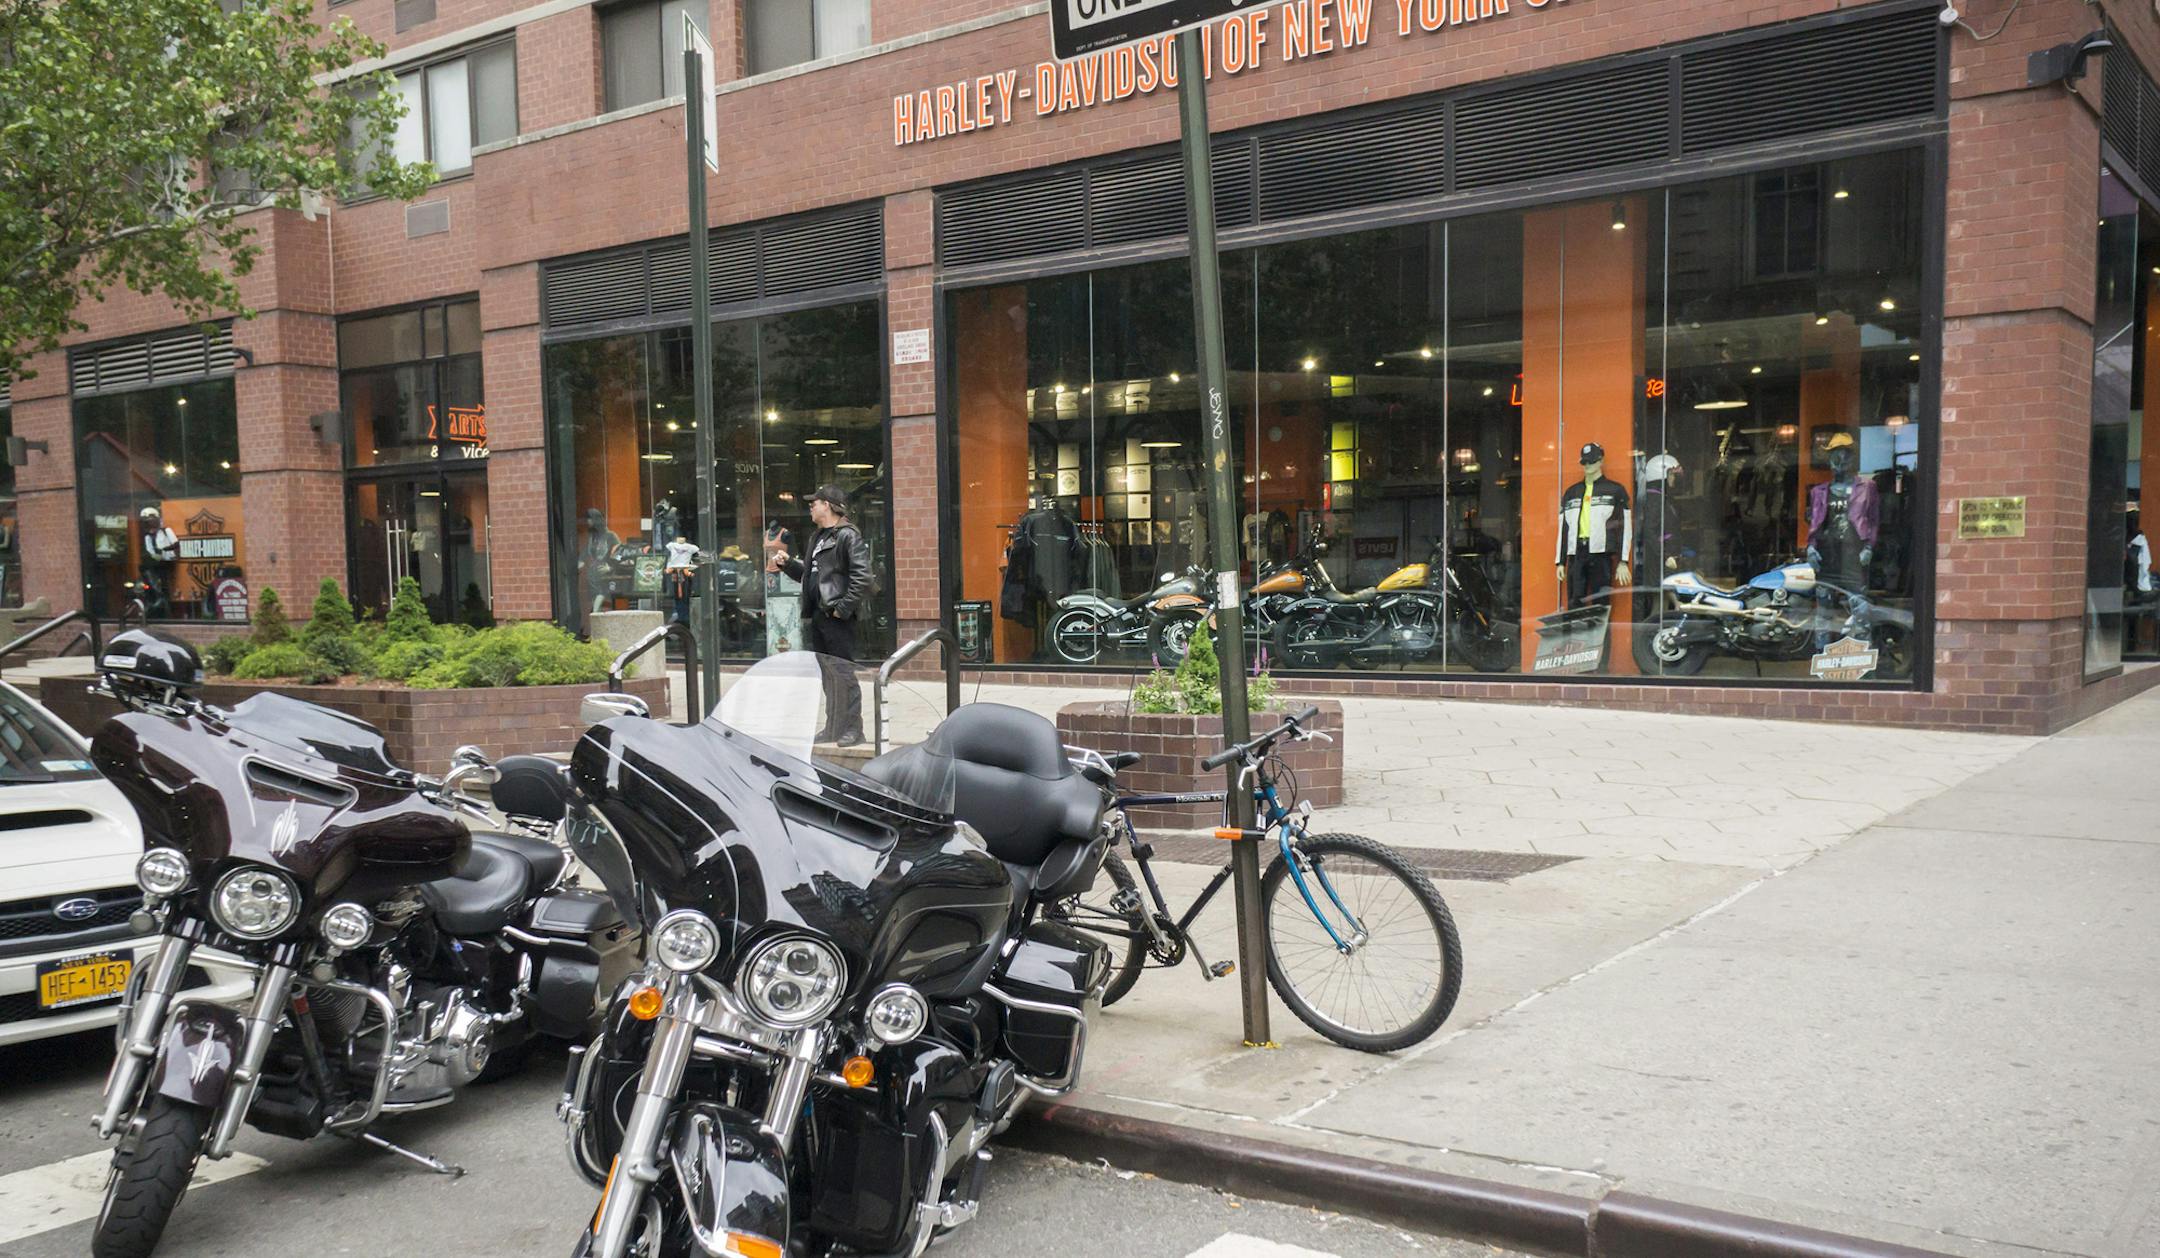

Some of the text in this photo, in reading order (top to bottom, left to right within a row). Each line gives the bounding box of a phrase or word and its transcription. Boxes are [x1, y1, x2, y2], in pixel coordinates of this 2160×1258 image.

[1222, 9, 1268, 74] OF
[1283, 0, 1374, 61] NEW
[447, 412, 488, 437] ARTS
[430, 443, 490, 459] & vice
[1534, 649, 1600, 671] HARLEY-DAVIDSON
[47, 963, 127, 998] HEF 1453
